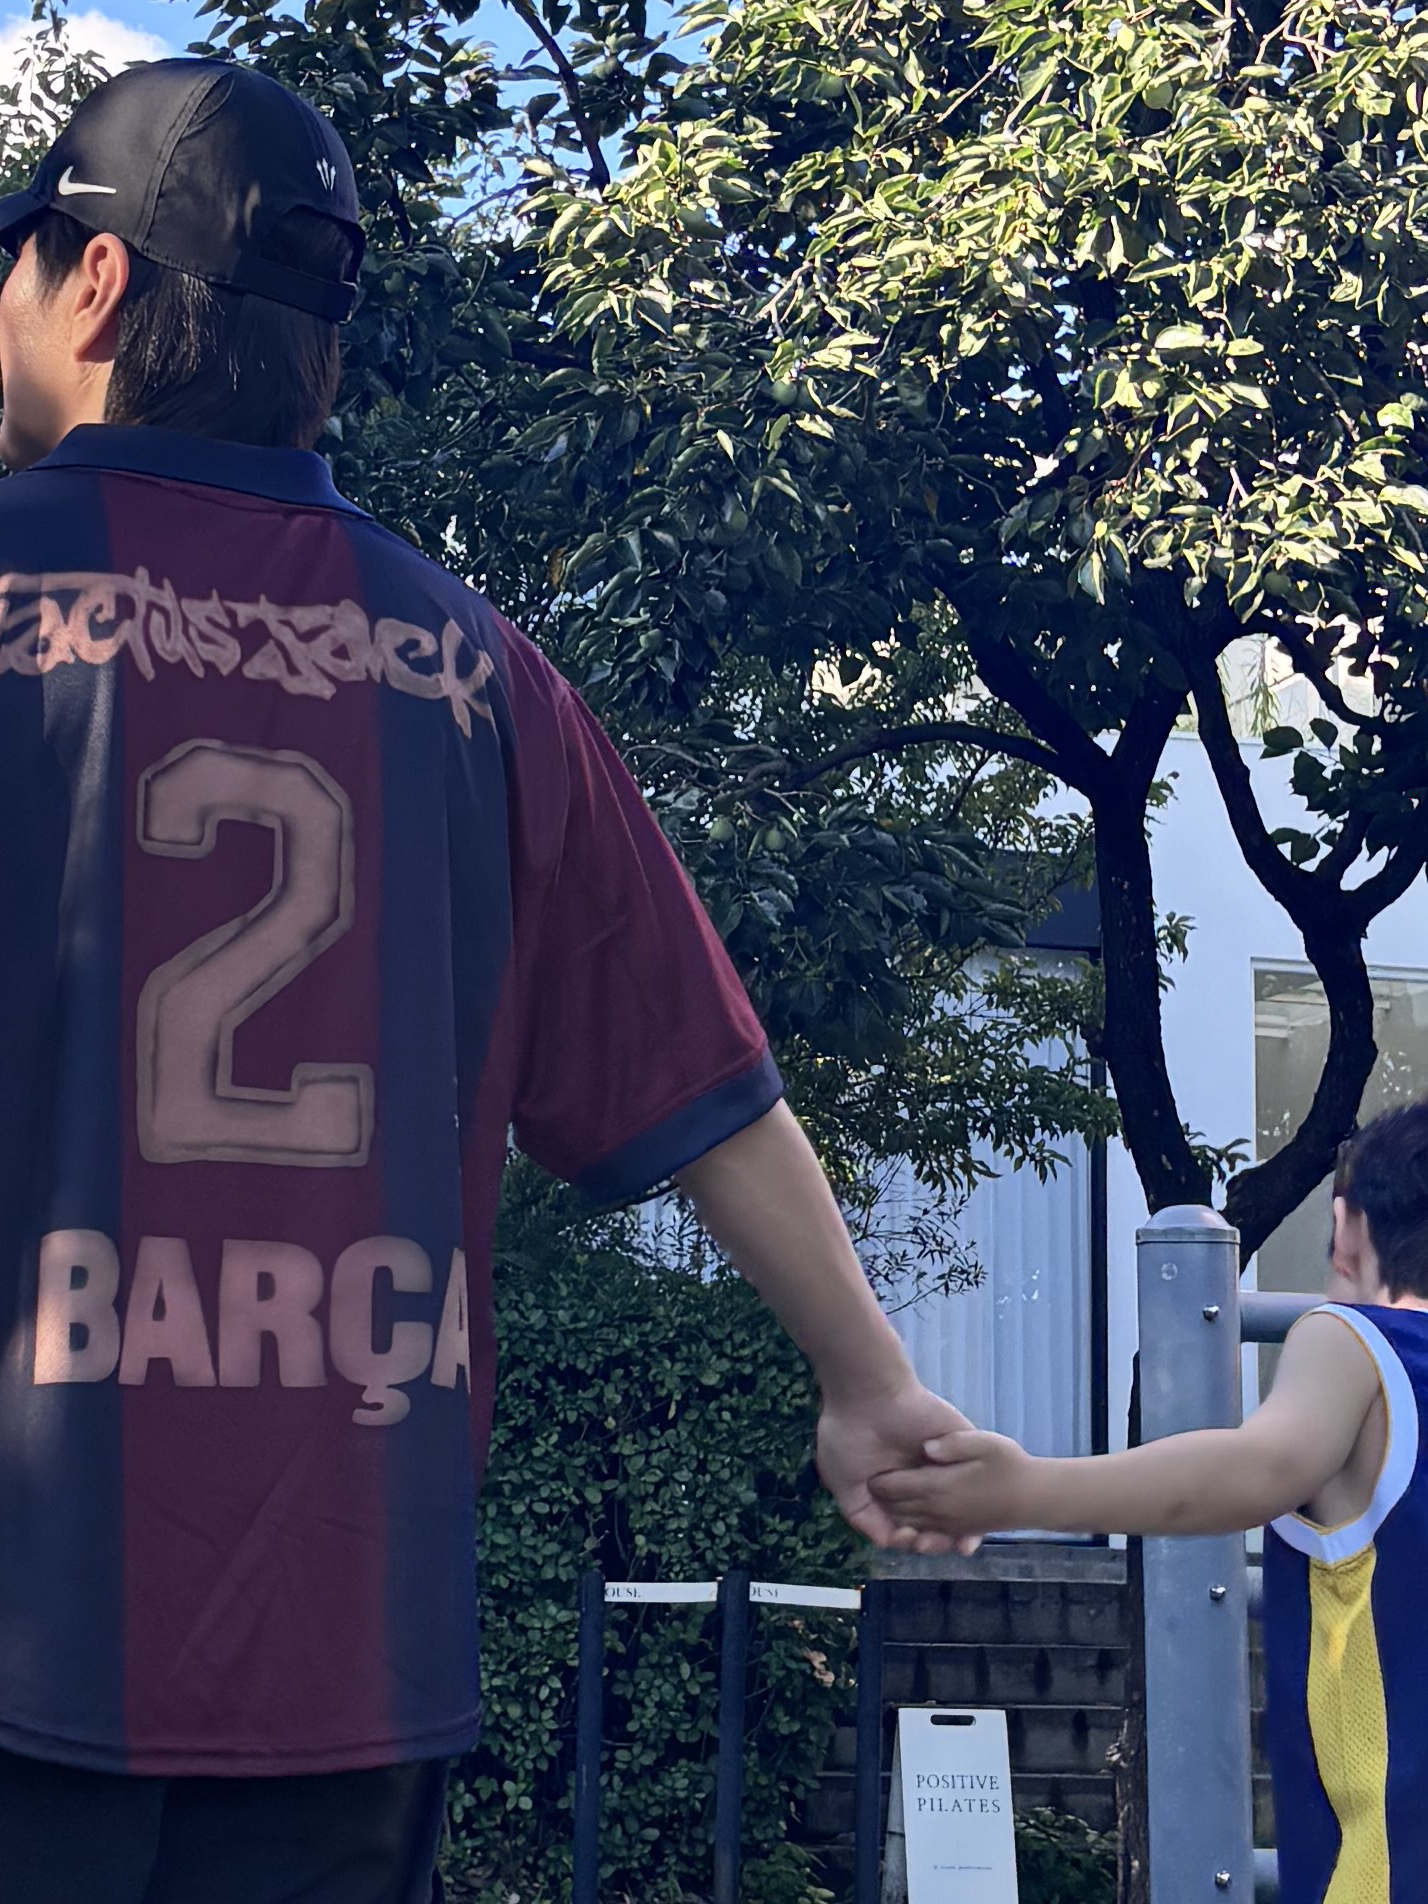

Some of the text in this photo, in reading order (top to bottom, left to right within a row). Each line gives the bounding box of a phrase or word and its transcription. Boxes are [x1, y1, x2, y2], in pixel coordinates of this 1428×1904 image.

[136, 737, 374, 1168] 2
[33, 1228, 472, 1427] BARÇA
[916, 1774, 1000, 1790] POSITIVE
[917, 1797, 1001, 1814] PILATES
